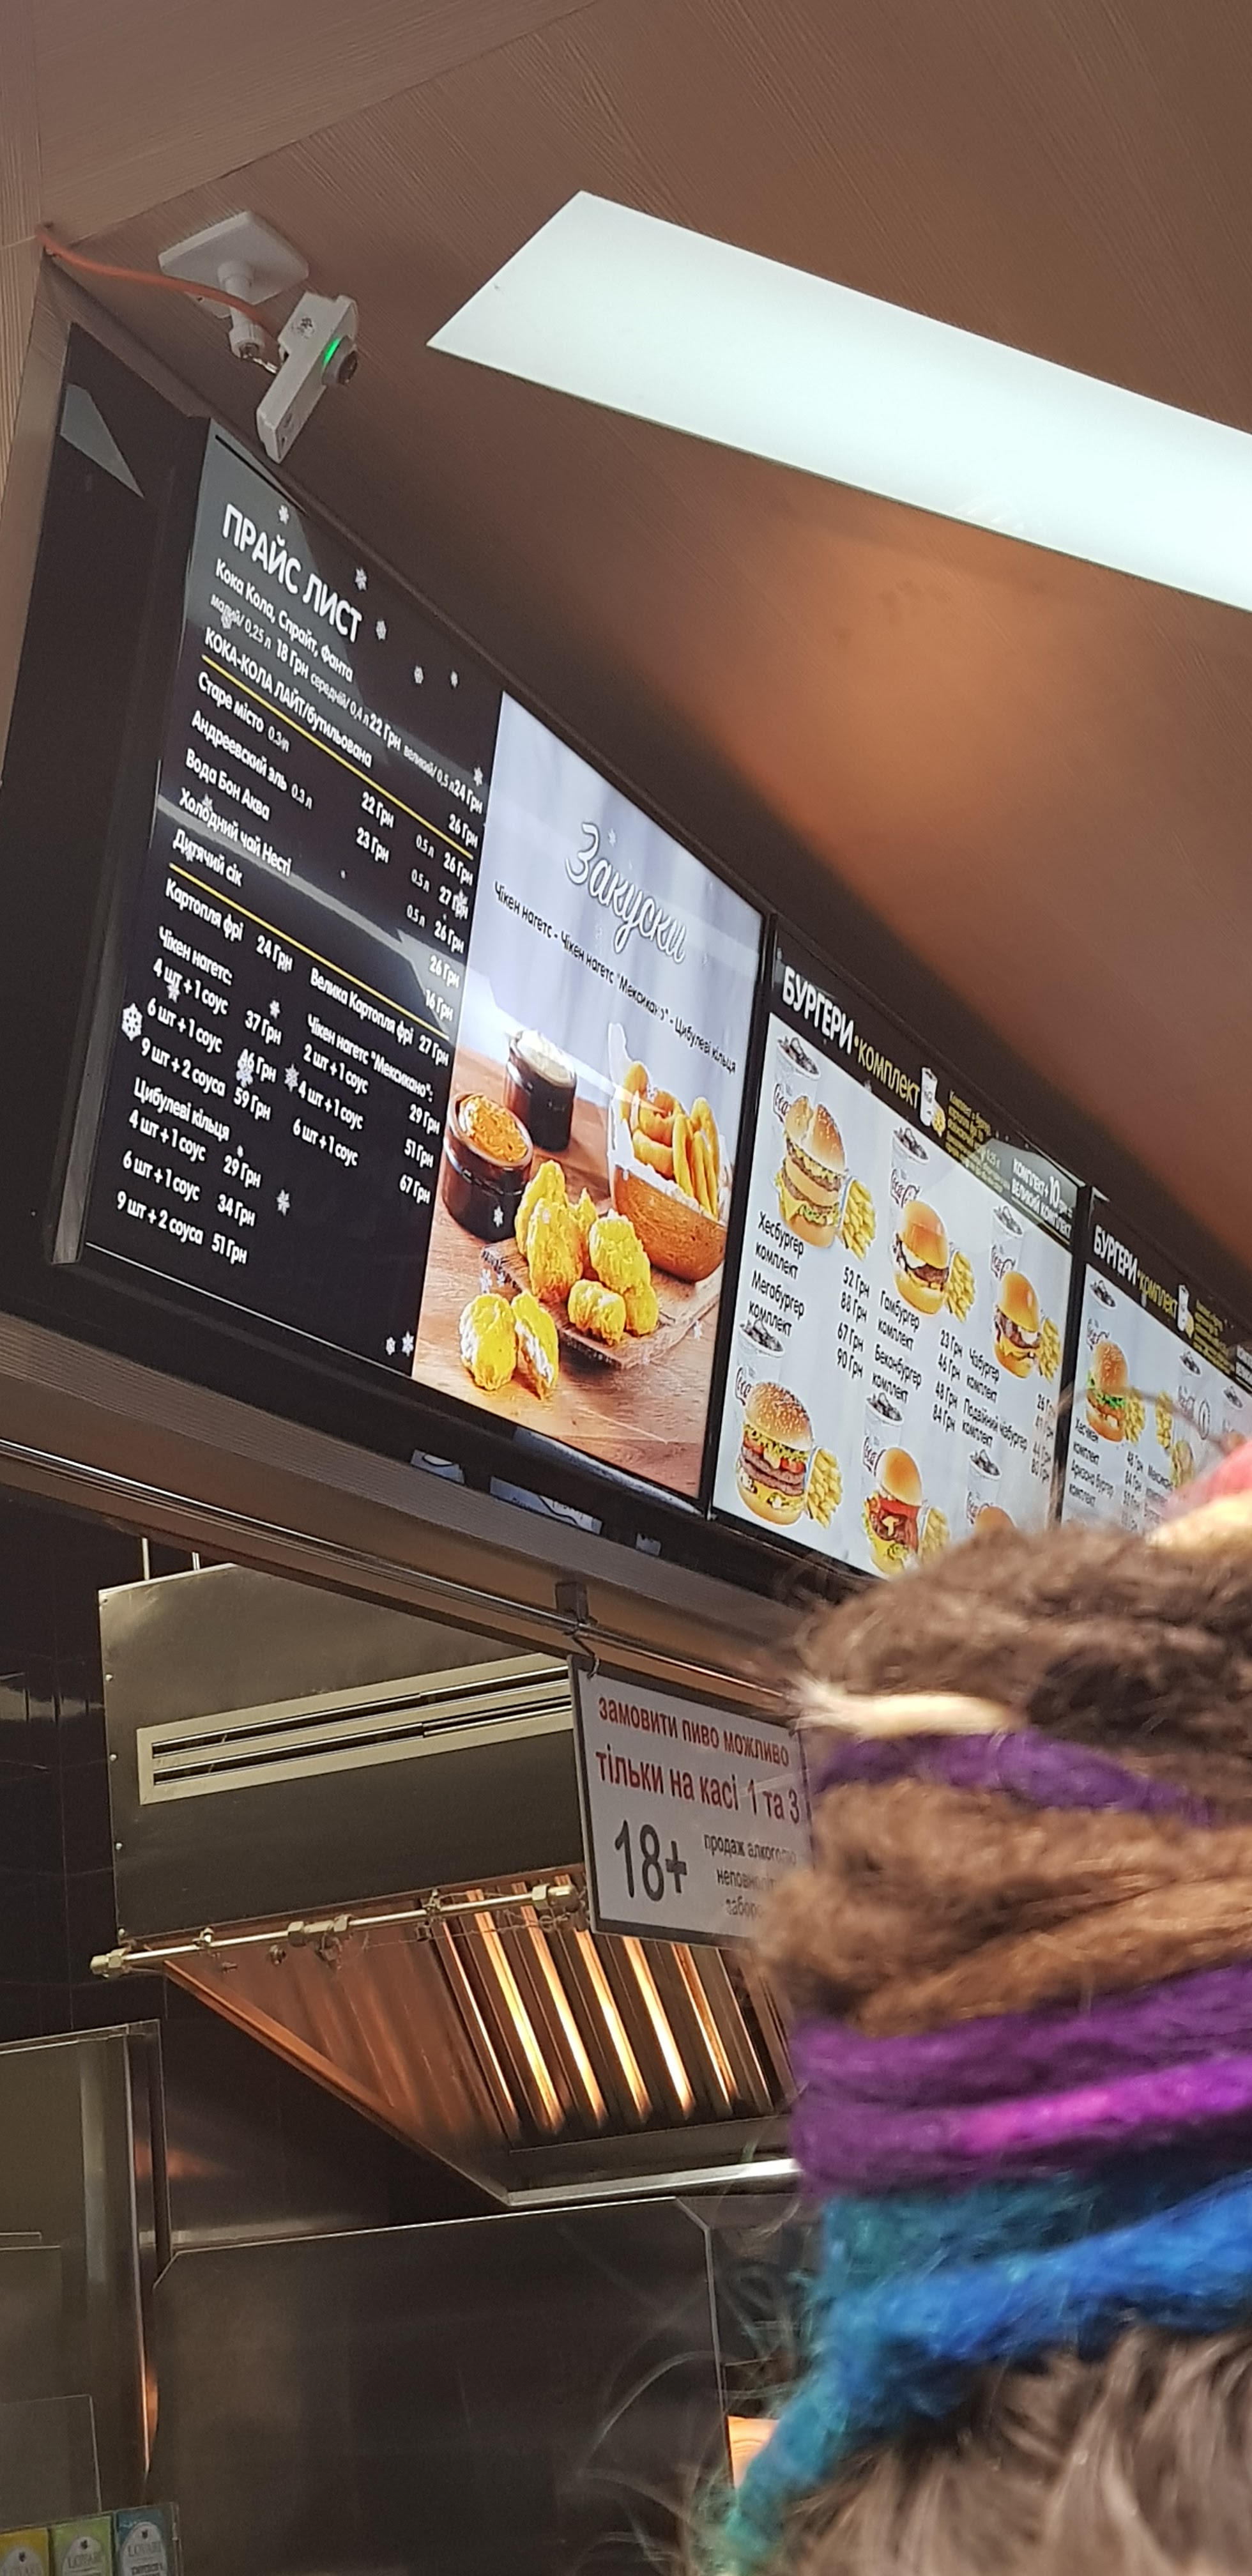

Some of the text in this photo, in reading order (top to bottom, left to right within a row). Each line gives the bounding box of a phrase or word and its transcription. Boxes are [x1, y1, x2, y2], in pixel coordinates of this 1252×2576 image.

[224, 505, 361, 641] ПРАЙС ЛИСТ
[216, 558, 353, 682] Кока Кола, Спрайт, Фанта
[277, 638, 288, 661] 18
[289, 650, 309, 678] Грн
[369, 714, 382, 736] 22
[383, 724, 401, 750] Грн
[199, 672, 232, 709] Старе
[234, 701, 264, 732] місто
[362, 792, 375, 814] 22
[376, 802, 393, 827] Грн
[444, 852, 455, 872] 26
[457, 861, 473, 885] Грн
[206, 627, 478, 848] КОКА-КОЛА ЛАЙТ/бутильована 26 Грн
[192, 711, 266, 776] Андреевский
[268, 767, 287, 790] эль
[356, 827, 370, 848] 23
[371, 837, 389, 862] Грн
[439, 886, 452, 905] 27
[452, 895, 468, 919] Грн
[453, 779, 466, 801] 24
[466, 789, 482, 813] Грн
[178, 788, 459, 988] Холодний чай Несті 26 Грн
[186, 749, 217, 783] Вода
[218, 770, 240, 800] Бон
[241, 788, 269, 820] Аква
[434, 921, 446, 940] 26
[448, 929, 464, 953] Грн
[166, 878, 293, 972] Картопля фрі 24 Грн
[173, 829, 453, 1021] Дитячий сік 16 Грн
[565, 822, 687, 965] Закуски
[159, 926, 232, 985] Чікен нагетс:
[495, 881, 520, 914] Чікен
[522, 906, 552, 938] нагетс
[561, 931, 584, 961] Чікен
[586, 954, 613, 983] нагетс
[675, 1018, 711, 1055] Цибулеві
[712, 1046, 735, 1073] кільця
[310, 968, 448, 1066] Велика Картопля фрі 27 Грн
[783, 967, 853, 1052] БУРГЕРИ
[142, 1038, 270, 1120] 9 шт + 2 соуса 59 Грн
[303, 1044, 439, 1134] 2 шт + 1 соус 29 Грн
[308, 1014, 432, 1101] Чікен нагетс "Мексикано":
[134, 1078, 229, 1141] Цибулеві кільця
[118, 1191, 247, 1264] 9 шт + 2 соуса 51 Грн
[1041, 1202, 1071, 1238] КОМПЛЕКТ
[1050, 1174, 1060, 1208] 10
[756, 1243, 798, 1278] комплект
[853, 1299, 867, 1322] Грн
[758, 1212, 869, 1298] Хесбургер 52 Грн
[1094, 1226, 1137, 1284] БУРГЕРИ
[749, 1301, 863, 1378] комплект 90 Грн
[752, 1271, 863, 1352] Мегабургер 67 Грн
[878, 1319, 960, 1381] комплект 46 Грн
[880, 1291, 963, 1357] Гамбургер 23 Грн
[873, 1373, 908, 1402] комплект
[943, 1411, 955, 1432] Грн
[875, 1344, 921, 1389] Беконбургер
[945, 1387, 958, 1408] Грн
[596, 1744, 799, 1824] тільки на касі 1 та 3
[682, 1720, 719, 1748] пиво
[724, 1731, 789, 1767] можливо
[615, 1821, 686, 1901] 18+
[704, 1834, 745, 1857] продаж
